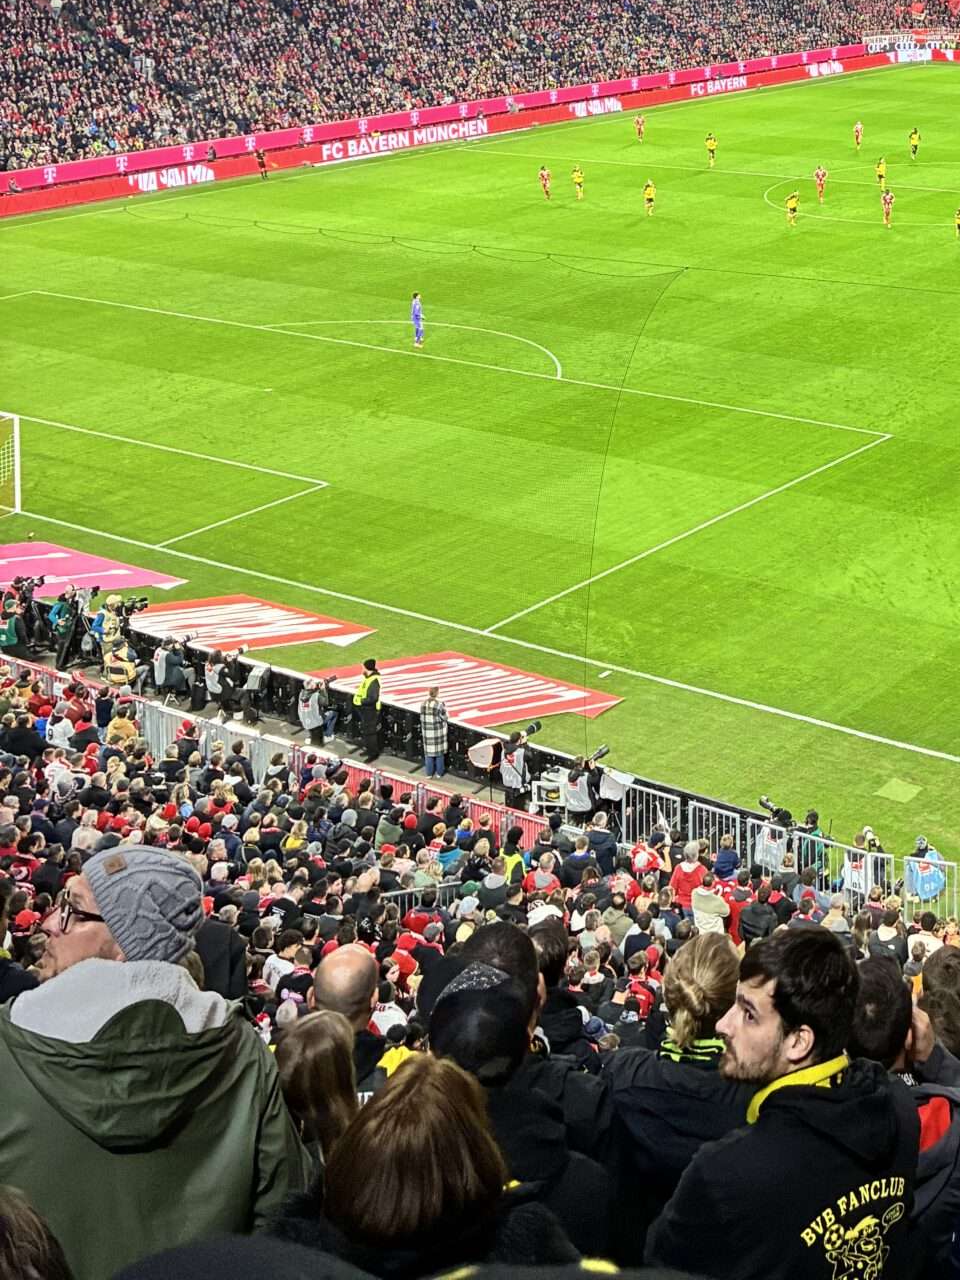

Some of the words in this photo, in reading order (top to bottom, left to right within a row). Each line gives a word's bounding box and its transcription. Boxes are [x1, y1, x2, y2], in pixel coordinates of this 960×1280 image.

[690, 82, 705, 96] FC
[707, 76, 747, 93] BAYERN
[322, 142, 343, 160] FC
[347, 130, 409, 156] BAYERN
[413, 119, 489, 144] MÜNCHEN
[800, 1207, 836, 1247] BVB
[836, 1176, 905, 1217] FANCLUB
